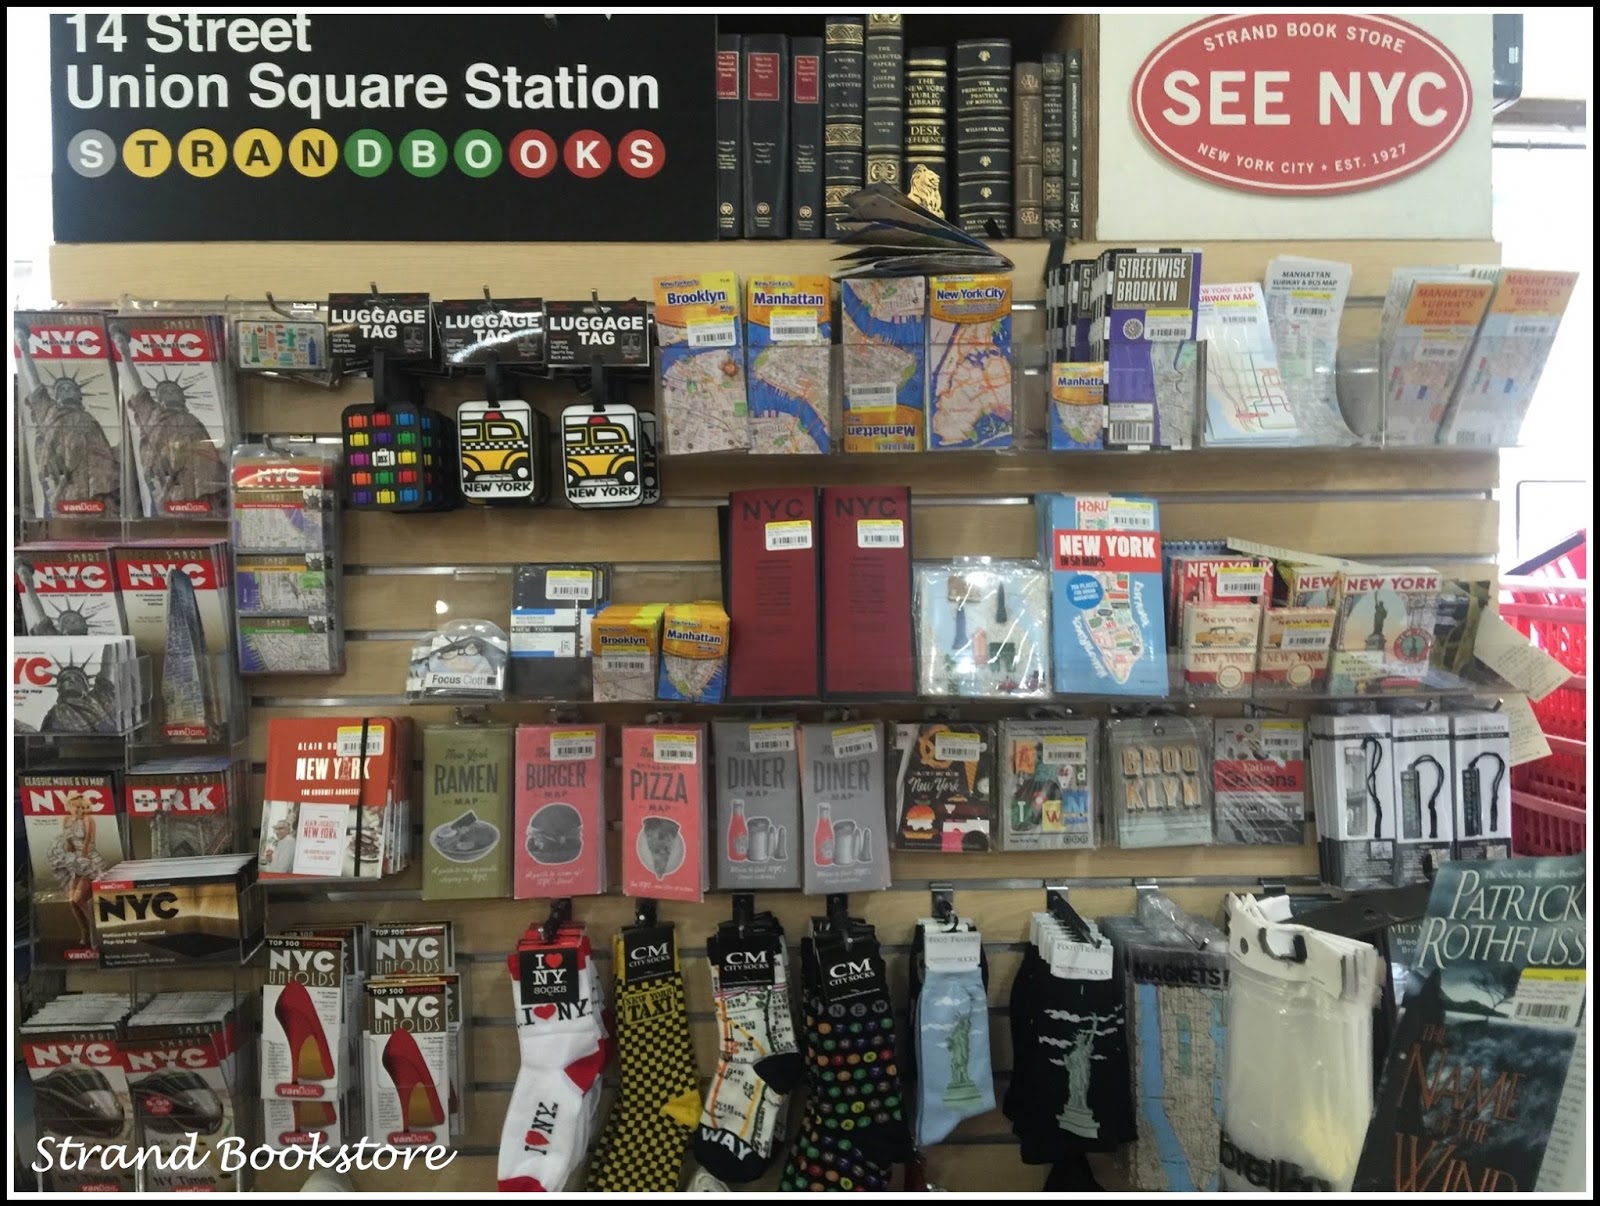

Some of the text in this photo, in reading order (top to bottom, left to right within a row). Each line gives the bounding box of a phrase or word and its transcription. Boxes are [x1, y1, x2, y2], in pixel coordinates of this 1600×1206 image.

[66, 14, 312, 52] 14 Street
[1203, 22, 1406, 54] STRAND BOOK STORE
[66, 62, 659, 120] Union Square Station
[1162, 70, 1448, 127] SEE NYC
[910, 126, 940, 136] DESK
[905, 136, 946, 144] REFERENCE
[1198, 142, 1408, 174] NEW YORK CITY EST. 1927
[1117, 257, 1187, 279] STREETWISE
[1281, 270, 1331, 279] MANHATTAN
[1505, 275, 1572, 288] MANHATTAN
[667, 290, 727, 305] Brooklyn
[754, 293, 824, 306] Manhattan
[936, 287, 1005, 301] New York City
[1116, 280, 1178, 303] BROOKLYN
[1234, 293, 1255, 302] MAP
[1417, 287, 1486, 299] MANHATTAN
[1421, 299, 1474, 309] SUBWAYS
[331, 309, 426, 325] LUGGAGE
[1426, 308, 1461, 318] BUSES
[445, 314, 540, 330] LUGGAGE
[549, 316, 644, 332] LUGGAGE
[359, 324, 398, 338] TAG
[472, 328, 513, 342] TAG
[577, 331, 616, 345] TAG
[29, 330, 101, 355] NYC
[129, 333, 204, 358] NYC
[847, 425, 916, 437] Manhattan
[463, 481, 532, 494] NEW YORK
[567, 485, 638, 498] NEW YORK
[743, 498, 805, 521] NYC
[834, 496, 898, 518] NYC
[1059, 534, 1157, 558] NEW YORK
[1060, 556, 1106, 567] IN MAPS
[33, 565, 108, 589] NYC
[127, 563, 206, 587] NYC
[1346, 577, 1438, 592] NEW YORK
[1203, 616, 1255, 624] NEW YORK
[600, 635, 646, 646] Brooklyn
[666, 628, 722, 644] Manhattan
[1193, 653, 1251, 664] NEW YORK
[1265, 652, 1324, 663] NEW YORK
[431, 673, 486, 685] Focus Cloth
[465, 748, 489, 765] York
[295, 757, 329, 780] NEW
[525, 762, 587, 791] BURGER
[727, 756, 786, 790] DINER
[813, 759, 871, 793] DINER
[24, 776, 104, 787] CLASSIC MOVIE TV MAP
[434, 762, 499, 795] RAMEN
[629, 769, 688, 804] PIZZA
[544, 790, 568, 799] MAP
[745, 790, 769, 798] MAP
[908, 776, 961, 799] New York
[131, 786, 219, 813] BRK
[453, 797, 479, 806] MAP
[830, 792, 855, 802] MAP
[303, 827, 338, 839] NEW YORK
[1447, 869, 1584, 922] PATRICK
[98, 891, 180, 922] NYC
[375, 928, 406, 936] TOP 500
[376, 937, 440, 961] NYC
[630, 942, 669, 961] CM
[1056, 942, 1079, 952] FOOT
[1417, 917, 1584, 970] ROTHFUSS
[269, 951, 335, 972] NYC
[534, 953, 545, 970] I
[628, 955, 671, 969] CITY SOCKS
[725, 950, 768, 965] CM
[376, 960, 440, 974] UNFOLDS
[724, 963, 770, 972] CITY SOCKS
[829, 958, 873, 979] CM
[1087, 967, 1110, 977] SOCKS
[269, 970, 336, 985] UNFOLDS
[532, 968, 567, 985] NY
[829, 971, 876, 987] CITY SOCKS
[372, 988, 387, 996] TOP
[388, 987, 404, 995] 500
[534, 986, 568, 995] SOCKS
[625, 988, 673, 1006] NEW YORK
[374, 995, 441, 1020] NYC
[522, 998, 589, 1026] I NY
[627, 996, 673, 1023] TAXI
[374, 1018, 441, 1034] UNFOLDS
[1421, 1023, 1447, 1043] THE
[32, 1044, 113, 1066] NYC
[126, 1048, 209, 1071] NYC
[1397, 1043, 1527, 1121] NAME
[525, 1102, 555, 1155] I NY
[701, 1128, 753, 1161] WAY
[1395, 1132, 1518, 1192] WIND
